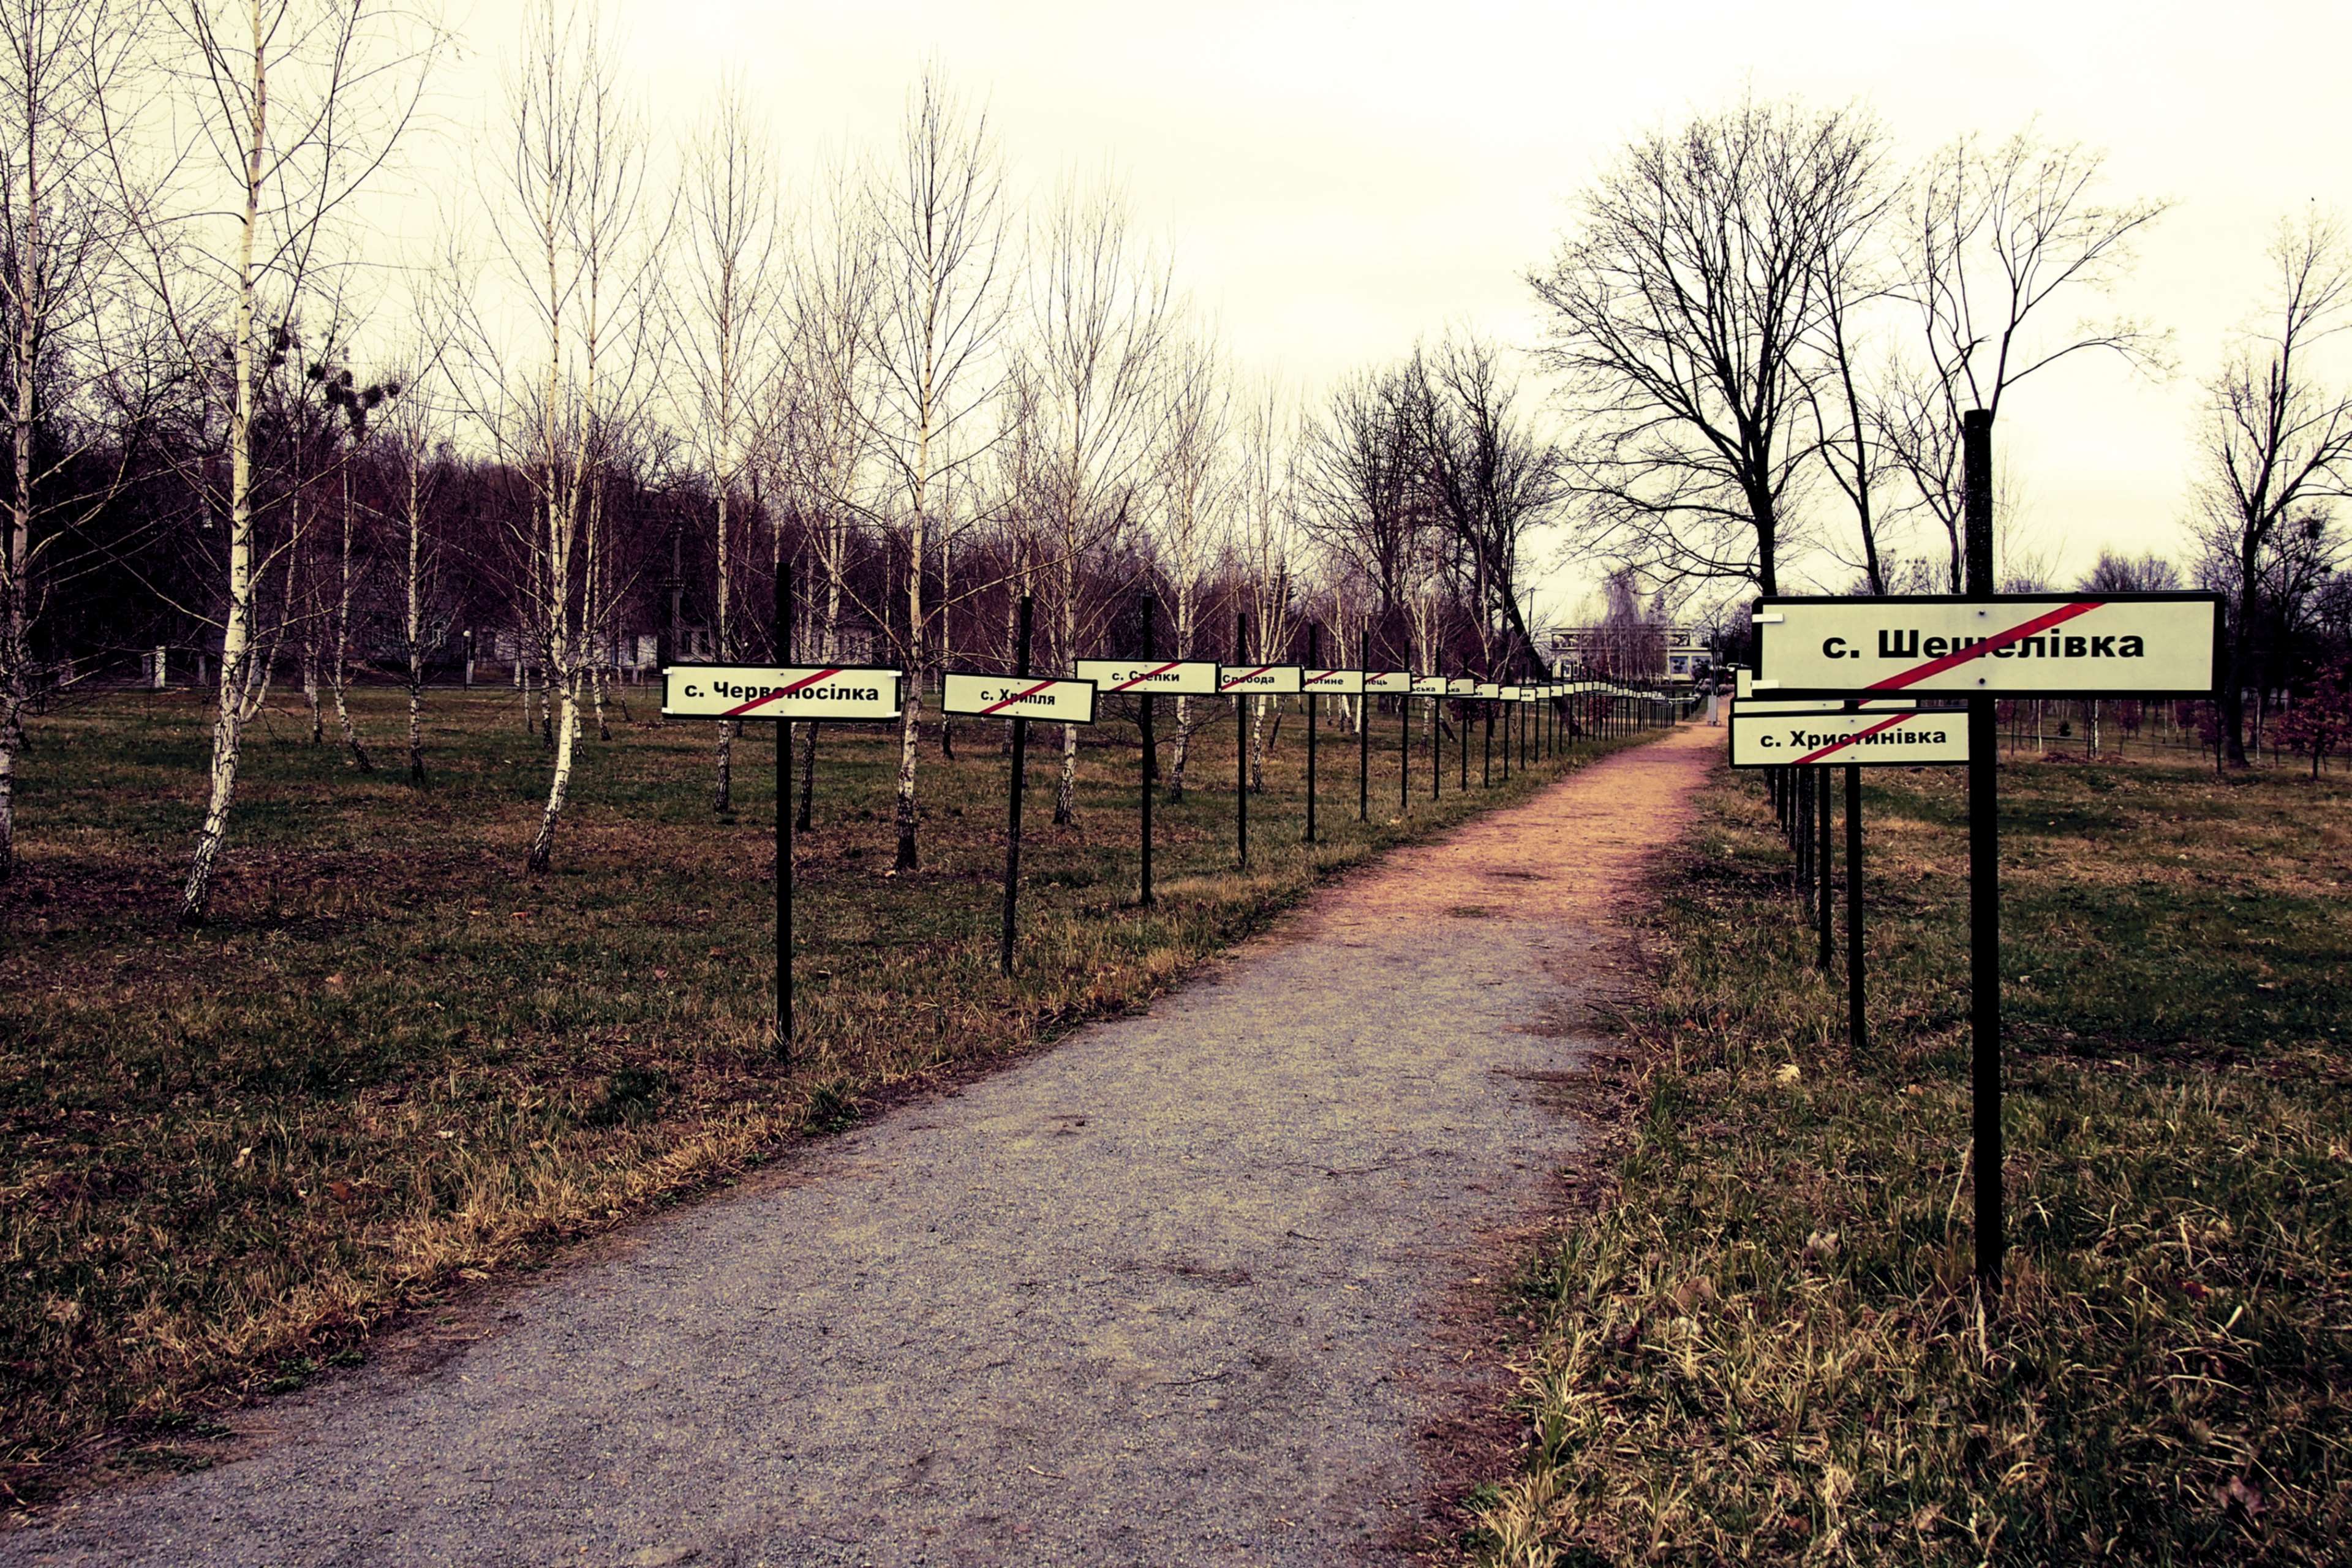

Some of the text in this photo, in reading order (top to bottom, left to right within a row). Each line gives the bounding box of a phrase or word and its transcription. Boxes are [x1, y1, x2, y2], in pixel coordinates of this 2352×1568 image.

[1822, 628, 2144, 658] с. Шешелівка
[684, 681, 878, 701] с. Червоносілка
[981, 688, 1055, 705] с. Хрипля
[1760, 728, 1947, 750] с. Христинівка
